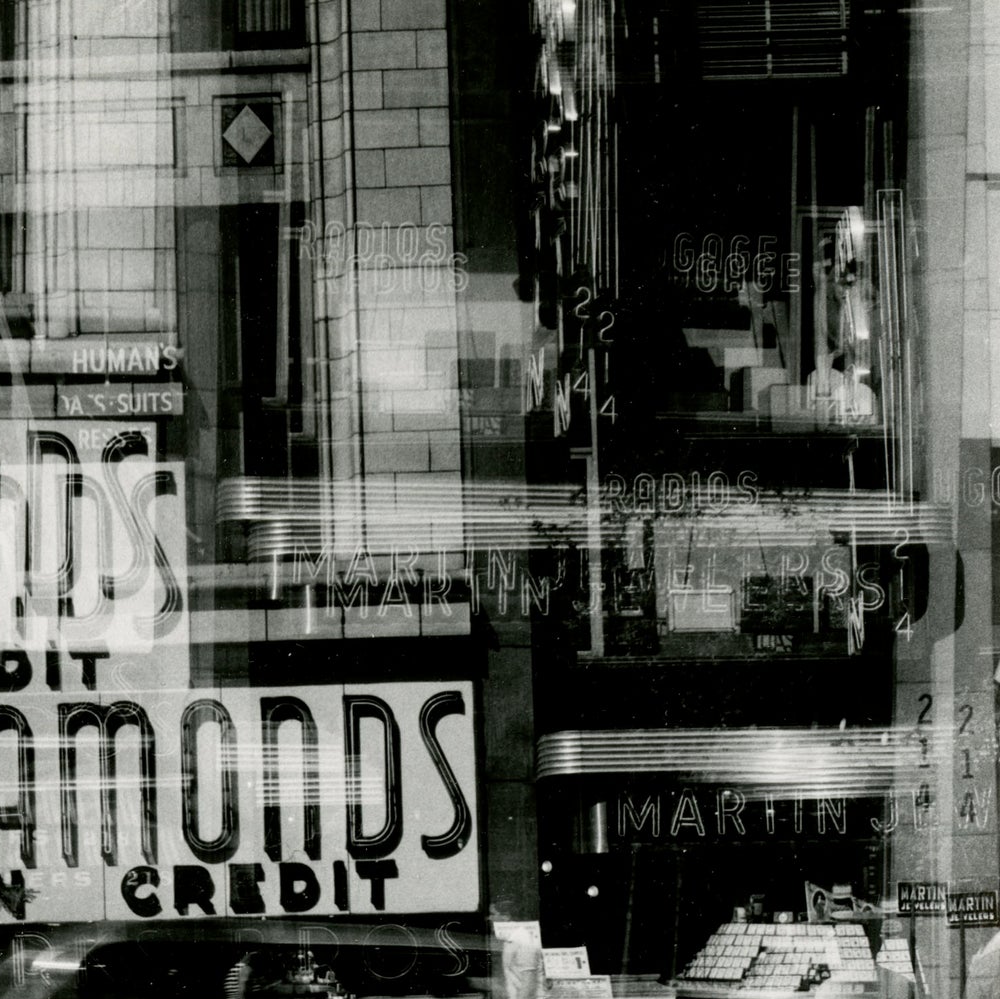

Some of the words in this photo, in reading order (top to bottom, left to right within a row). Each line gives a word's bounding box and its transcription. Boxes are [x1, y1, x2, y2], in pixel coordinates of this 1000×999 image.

[298, 220, 449, 262] RADIOS
[117, 391, 173, 413] SUITS
[605, 471, 760, 514] RADIOS
[326, 571, 549, 617] MARTIN
[618, 788, 846, 836] MARTIN
[121, 859, 399, 918] CREDIT
[900, 886, 946, 900] MARTIN
[950, 897, 994, 912] MARTIN
